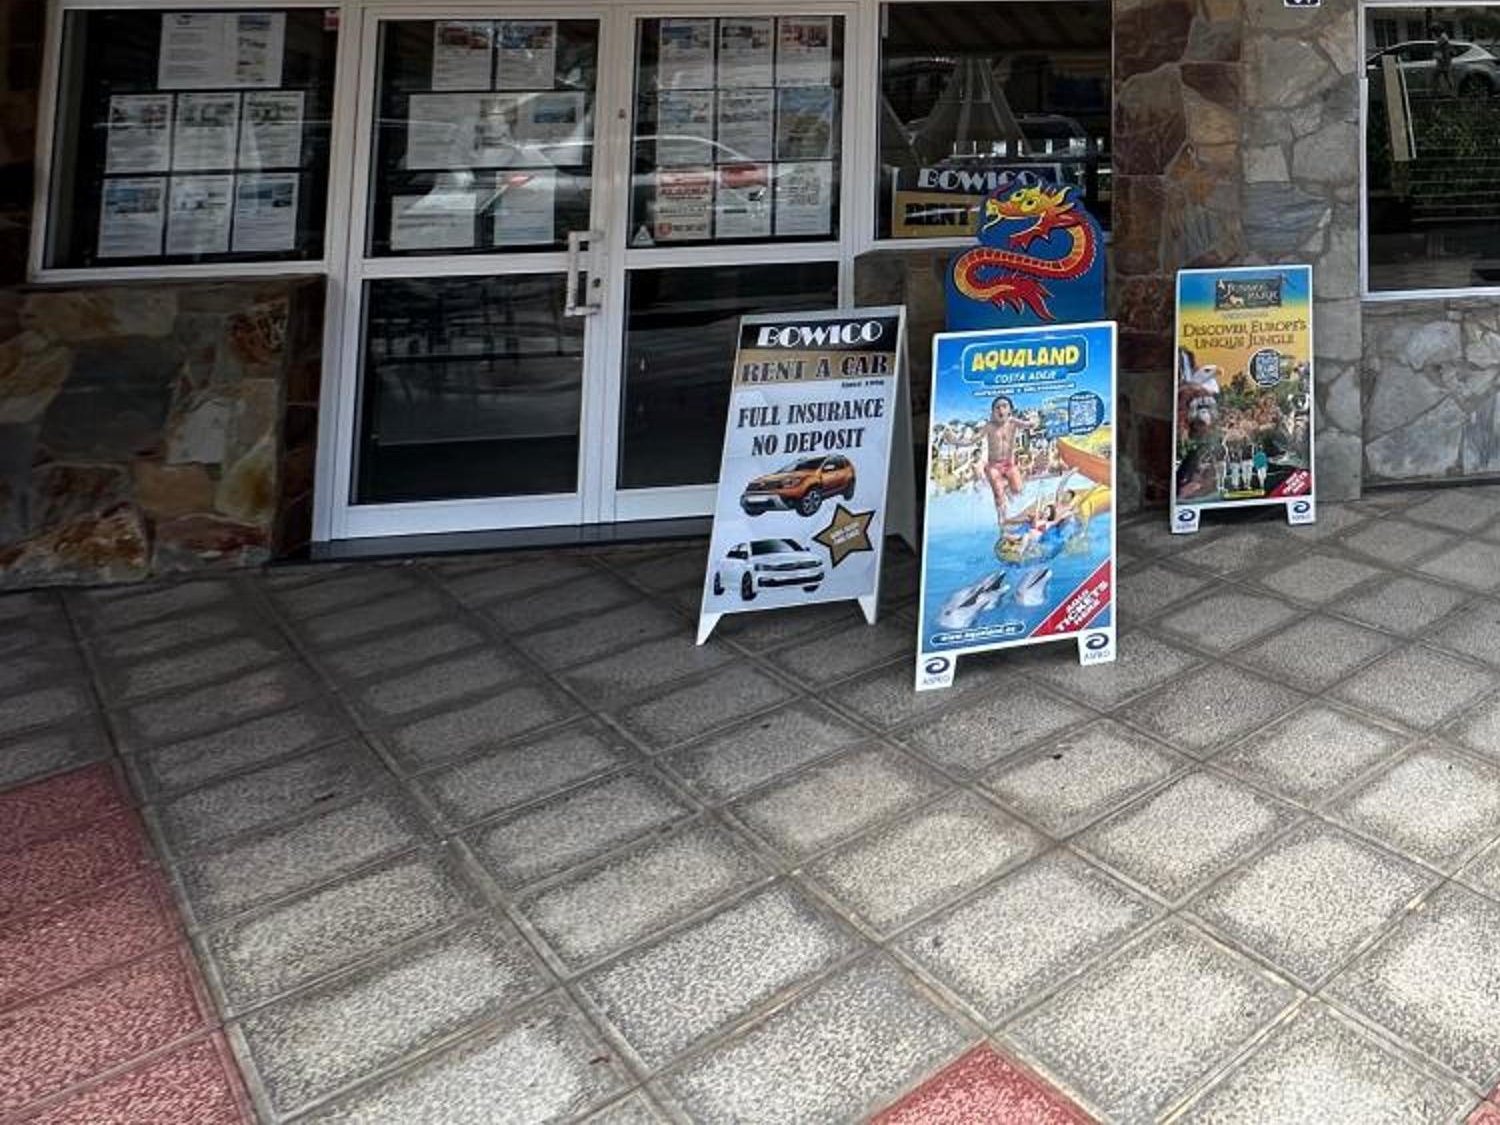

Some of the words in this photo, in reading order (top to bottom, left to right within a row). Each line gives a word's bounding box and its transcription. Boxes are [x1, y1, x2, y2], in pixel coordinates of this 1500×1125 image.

[757, 321, 883, 348] BOWICO
[1183, 322, 1248, 337] DISCOVER
[1248, 333, 1295, 348] JUNGLE
[741, 360, 807, 382] RENT
[815, 358, 831, 378] A
[841, 355, 887, 376] CAR
[972, 345, 1080, 372] AQUALAND
[738, 405, 780, 428] FULL
[788, 398, 885, 425] INSURANCE
[752, 433, 778, 456] NO
[784, 428, 865, 454] DEPOSIT
